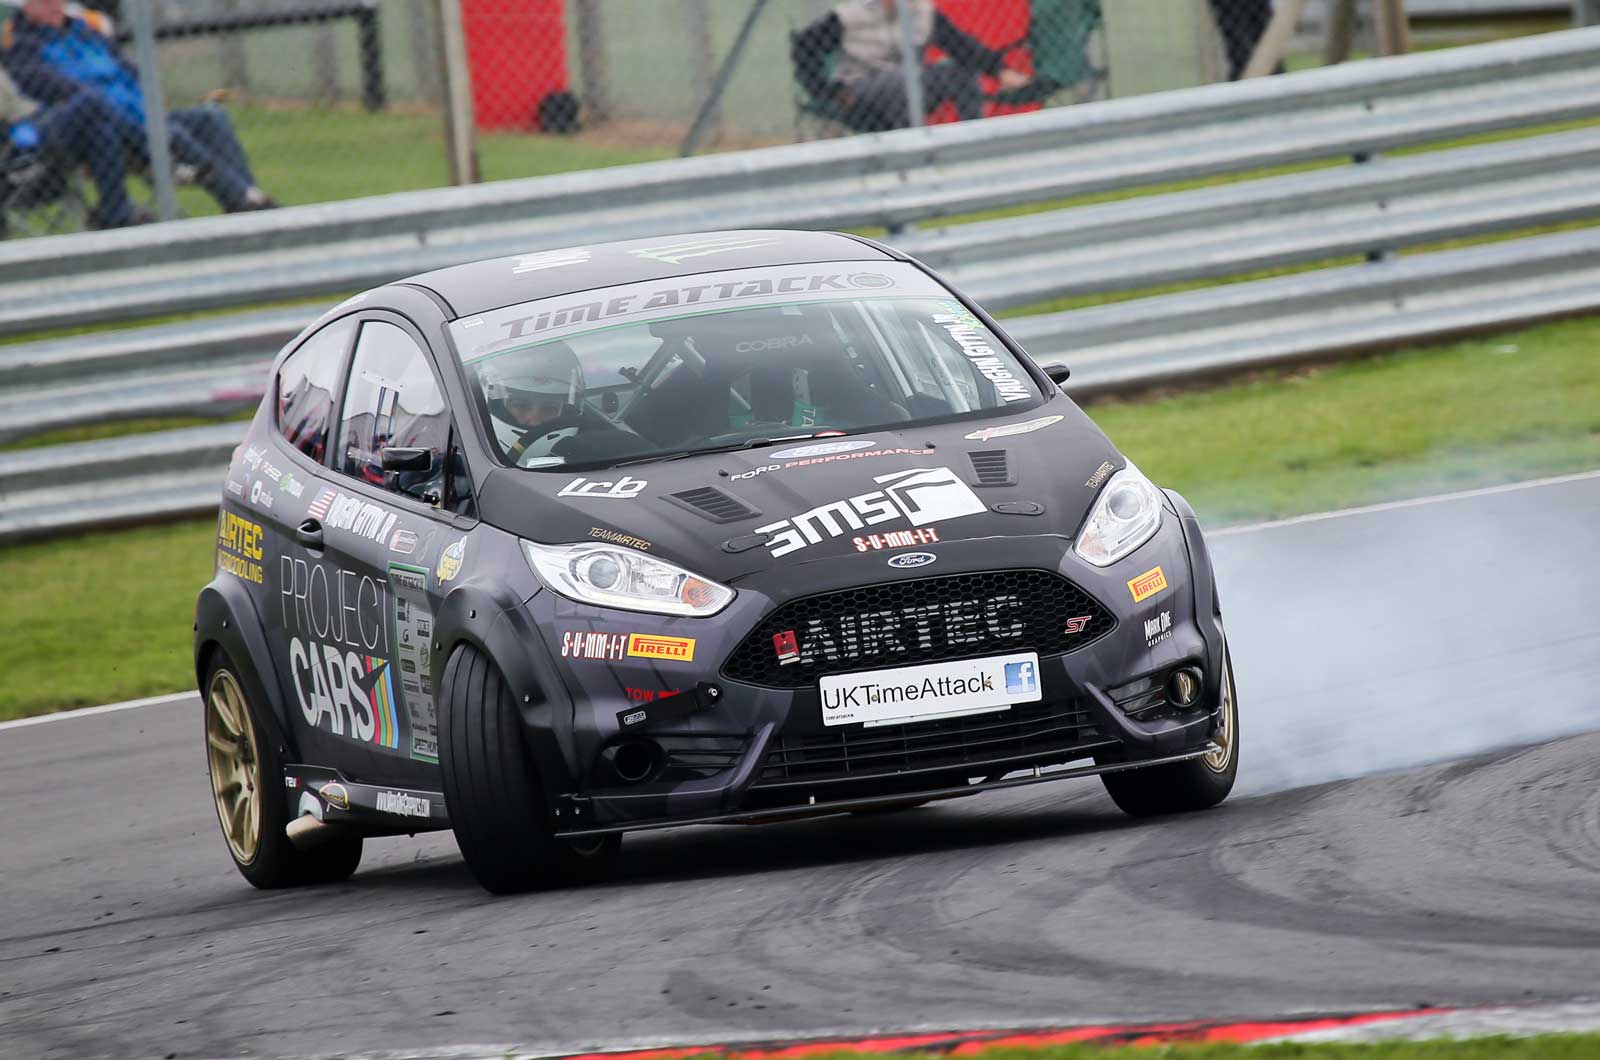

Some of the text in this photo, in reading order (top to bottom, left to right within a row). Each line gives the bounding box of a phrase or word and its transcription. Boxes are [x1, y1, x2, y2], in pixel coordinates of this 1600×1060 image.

[643, 274, 848, 310] ATTACK
[735, 334, 814, 353] COBRA
[731, 448, 935, 482] FORD PERFORMANCE
[219, 509, 263, 560] AIRTEC
[588, 527, 652, 551] TEAMAIRTEC
[895, 554, 930, 567] Ford
[1133, 571, 1163, 597] PIRELLI
[281, 555, 389, 653] PROJECT
[801, 596, 1026, 664] AIRTEC
[1065, 615, 1092, 634] ST
[633, 638, 688, 656] PIRELLI
[290, 637, 375, 742] CARS
[625, 687, 655, 703] TOW
[823, 671, 995, 710] UKTimeAttack
